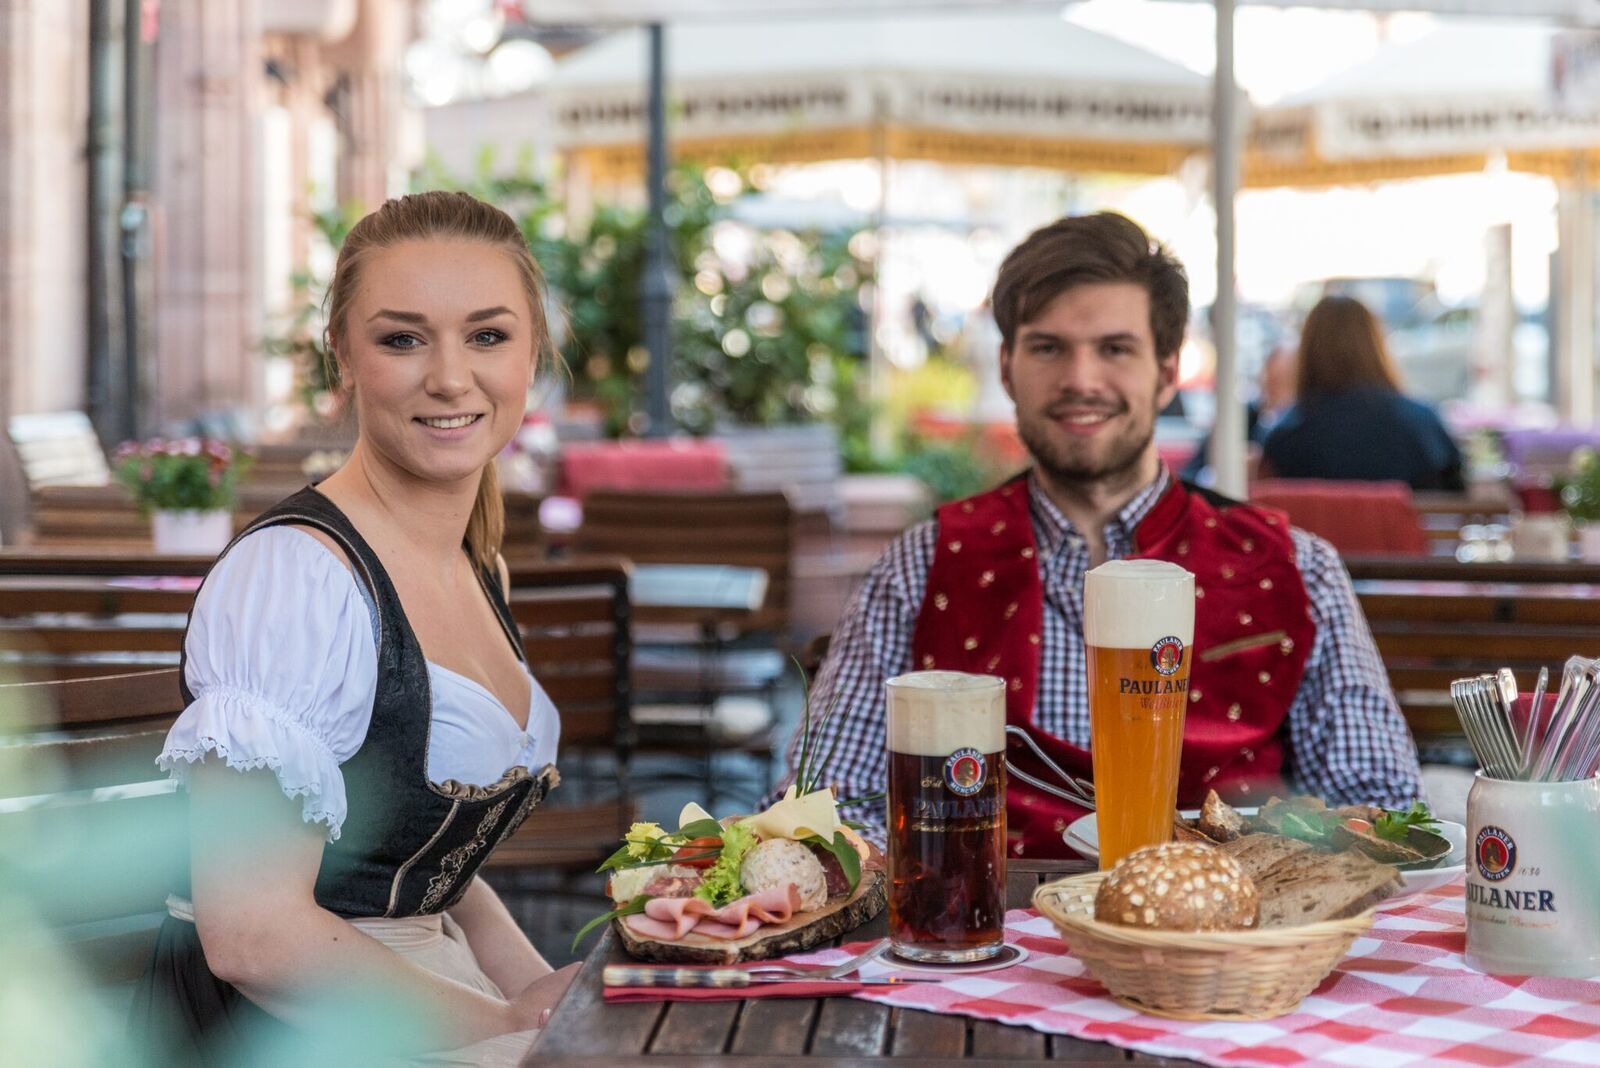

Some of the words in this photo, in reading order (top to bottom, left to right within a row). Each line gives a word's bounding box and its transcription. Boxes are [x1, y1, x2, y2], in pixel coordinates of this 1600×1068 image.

[1153, 637, 1182, 652] PAULANER
[1120, 679, 1187, 694] PAULANE
[947, 749, 984, 766] PAULANER
[1477, 828, 1513, 849] PAULANER
[1467, 883, 1555, 911] AULANER
